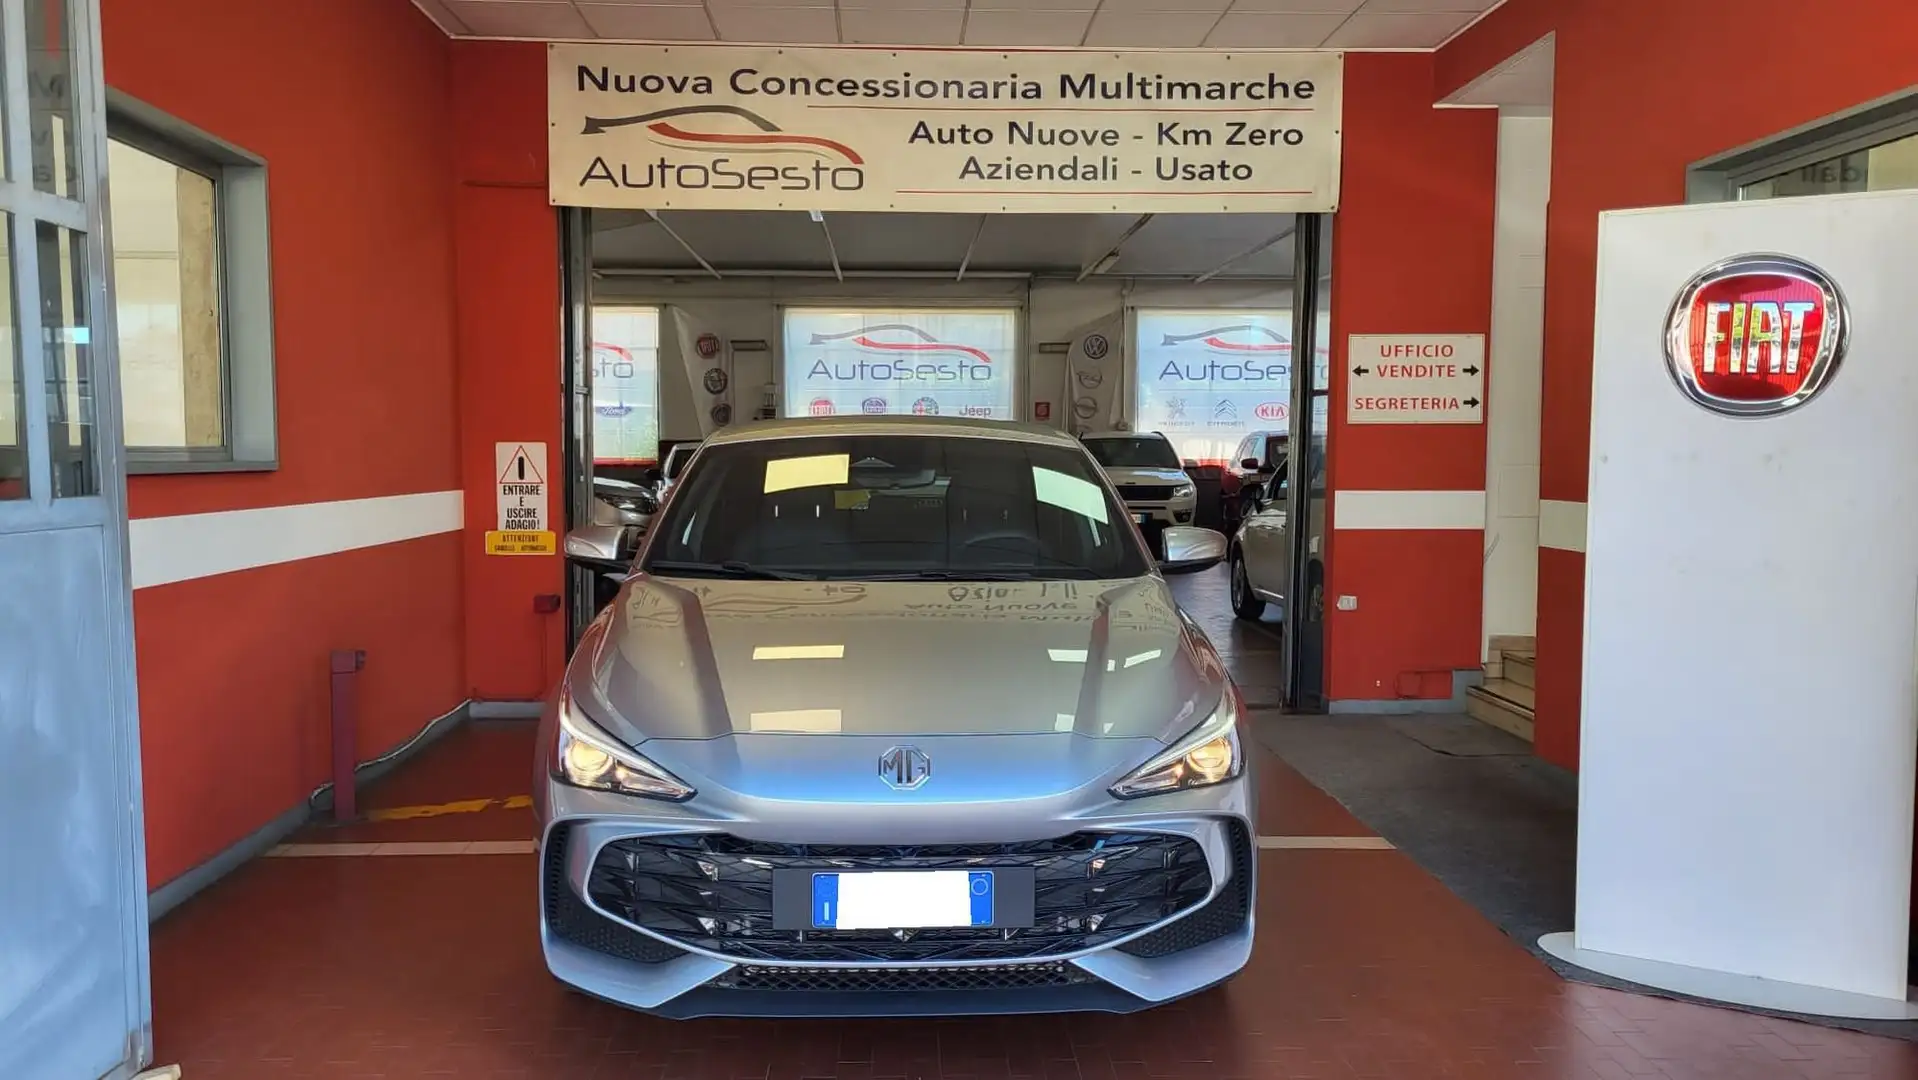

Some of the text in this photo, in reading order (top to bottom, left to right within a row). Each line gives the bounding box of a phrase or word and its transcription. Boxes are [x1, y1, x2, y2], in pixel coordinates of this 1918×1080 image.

[578, 65, 1315, 101] Nuova Concessionaria Multimarche
[908, 120, 994, 145] Auto
[1008, 121, 1120, 147] Nuove
[1157, 122, 1212, 146] Km
[1225, 122, 1304, 146] Zero
[579, 155, 865, 191] AutoSesto
[959, 155, 1118, 181] Aziendali
[1156, 156, 1253, 181] Usato
[1703, 302, 1815, 374] FIAT
[1380, 344, 1454, 358] UFFICIO
[807, 358, 992, 381] AutoSesto
[1376, 364, 1456, 378] VENDITE
[1355, 397, 1460, 410] SEGRETERIA
[958, 404, 992, 418] Jeep
[1260, 405, 1285, 417] KIA
[503, 485, 540, 496] ENTRARE
[519, 496, 525, 507] E
[506, 507, 538, 519] USCIRE
[505, 519, 540, 530] ADAGIO!
[882, 748, 927, 784] MG
